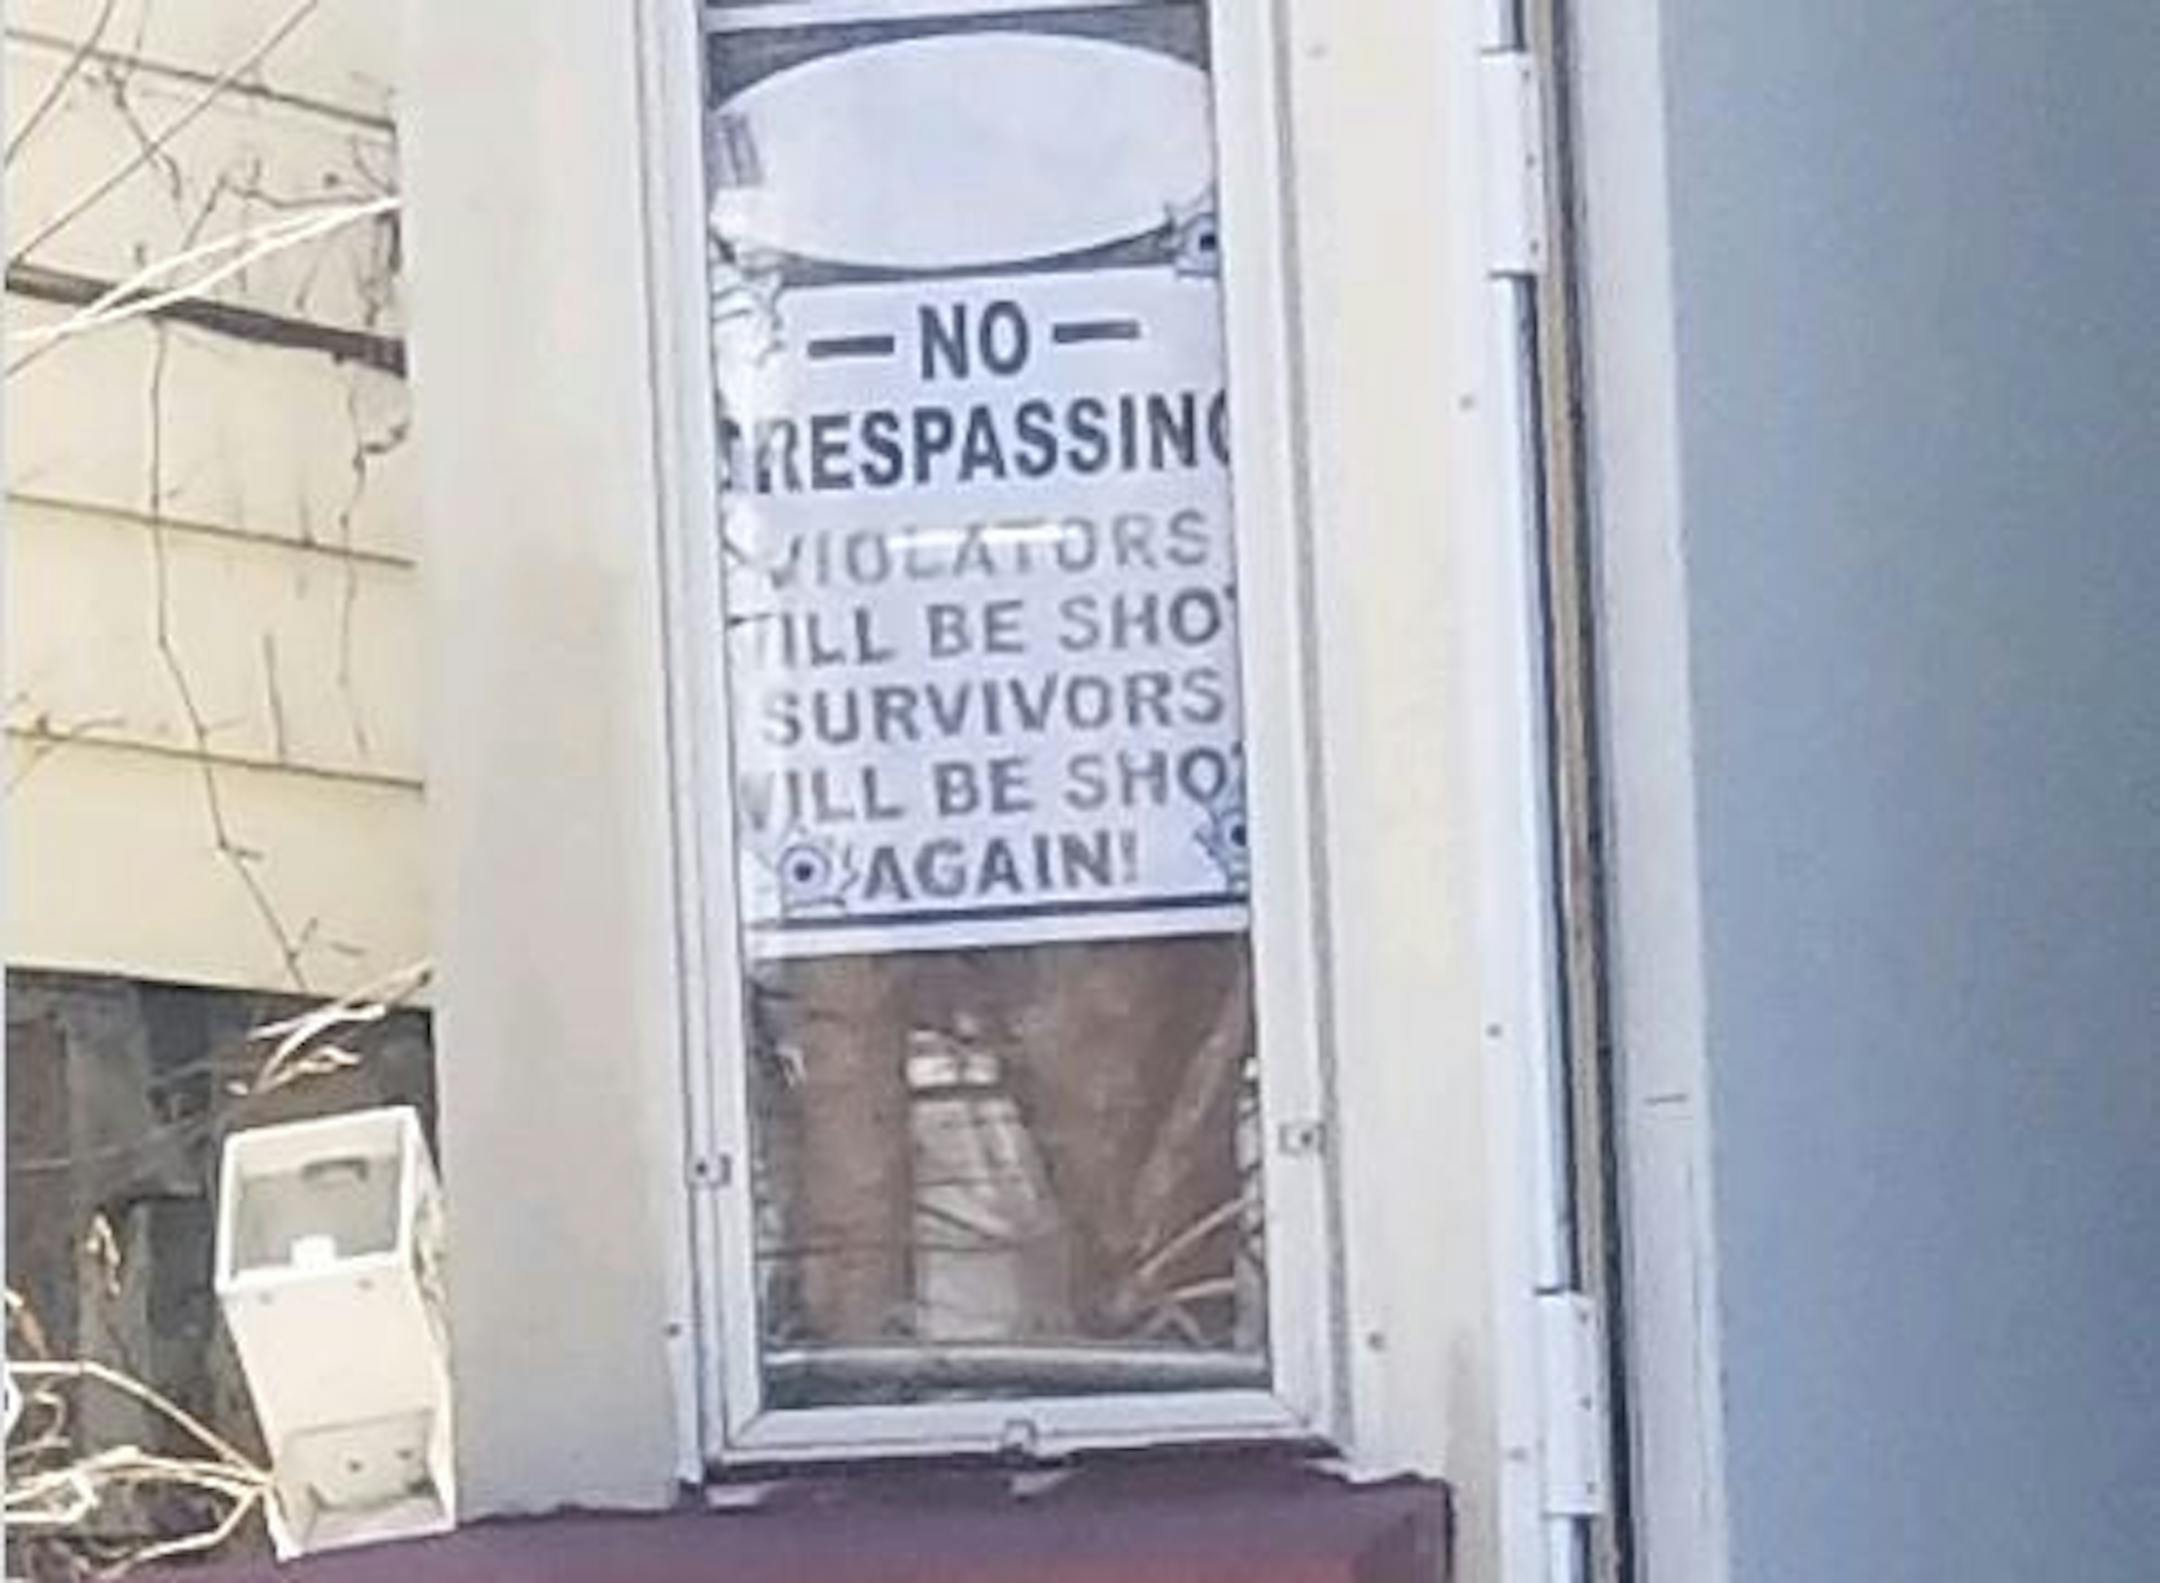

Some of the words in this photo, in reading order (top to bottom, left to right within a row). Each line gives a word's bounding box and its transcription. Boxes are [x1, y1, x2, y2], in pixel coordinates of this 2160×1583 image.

[918, 299, 1030, 381] NO
[756, 608, 897, 668] ILL
[927, 600, 1025, 658] BE
[1058, 583, 1238, 652] SHO
[763, 667, 1224, 746] SURVIVORS
[935, 757, 1035, 818] BE
[1066, 740, 1243, 808] SHO
[863, 829, 1139, 900] AGAIN!
